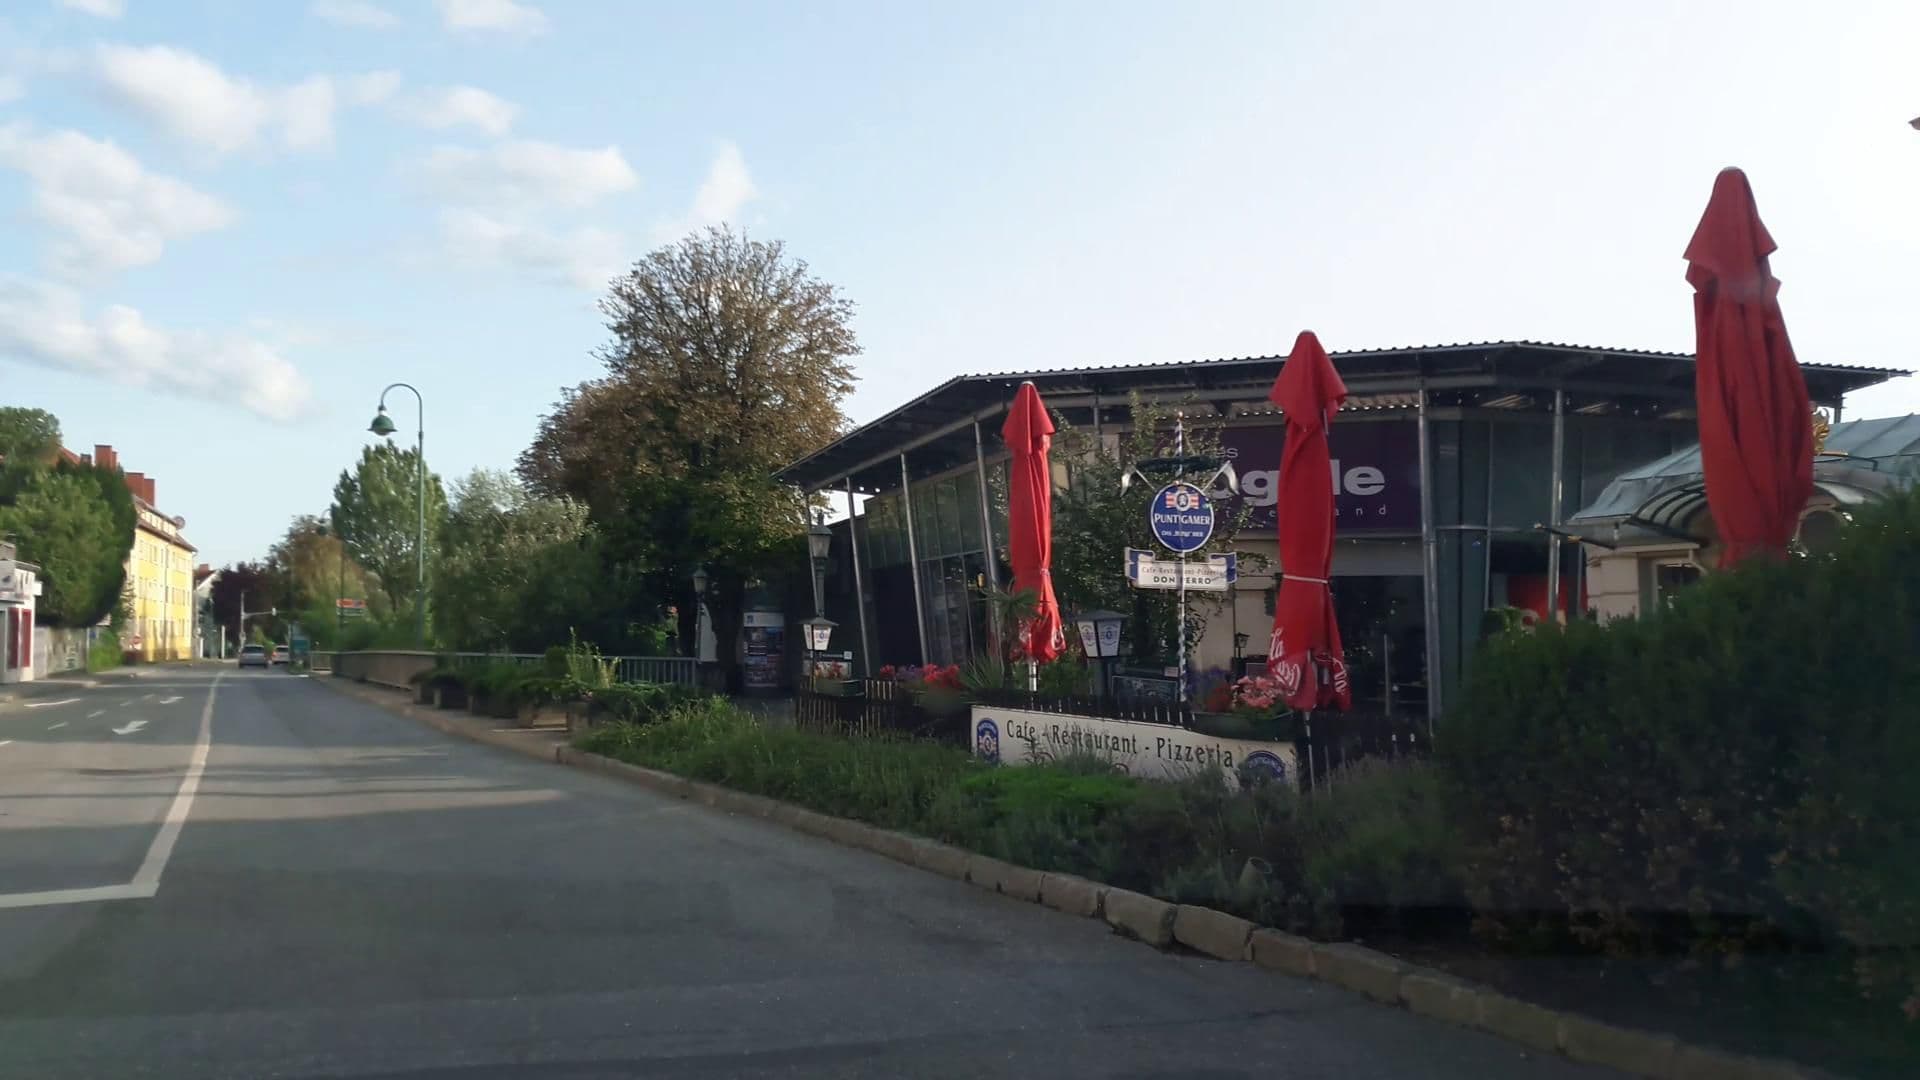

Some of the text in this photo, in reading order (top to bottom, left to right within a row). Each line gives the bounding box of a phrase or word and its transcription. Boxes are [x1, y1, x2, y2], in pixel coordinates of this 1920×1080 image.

[1154, 513, 1210, 525] PUNTIGAMER
[1180, 577, 1212, 585] ERRO
[1052, 724, 1138, 755] Restaurant
[1156, 737, 1234, 768] Pizzeria
